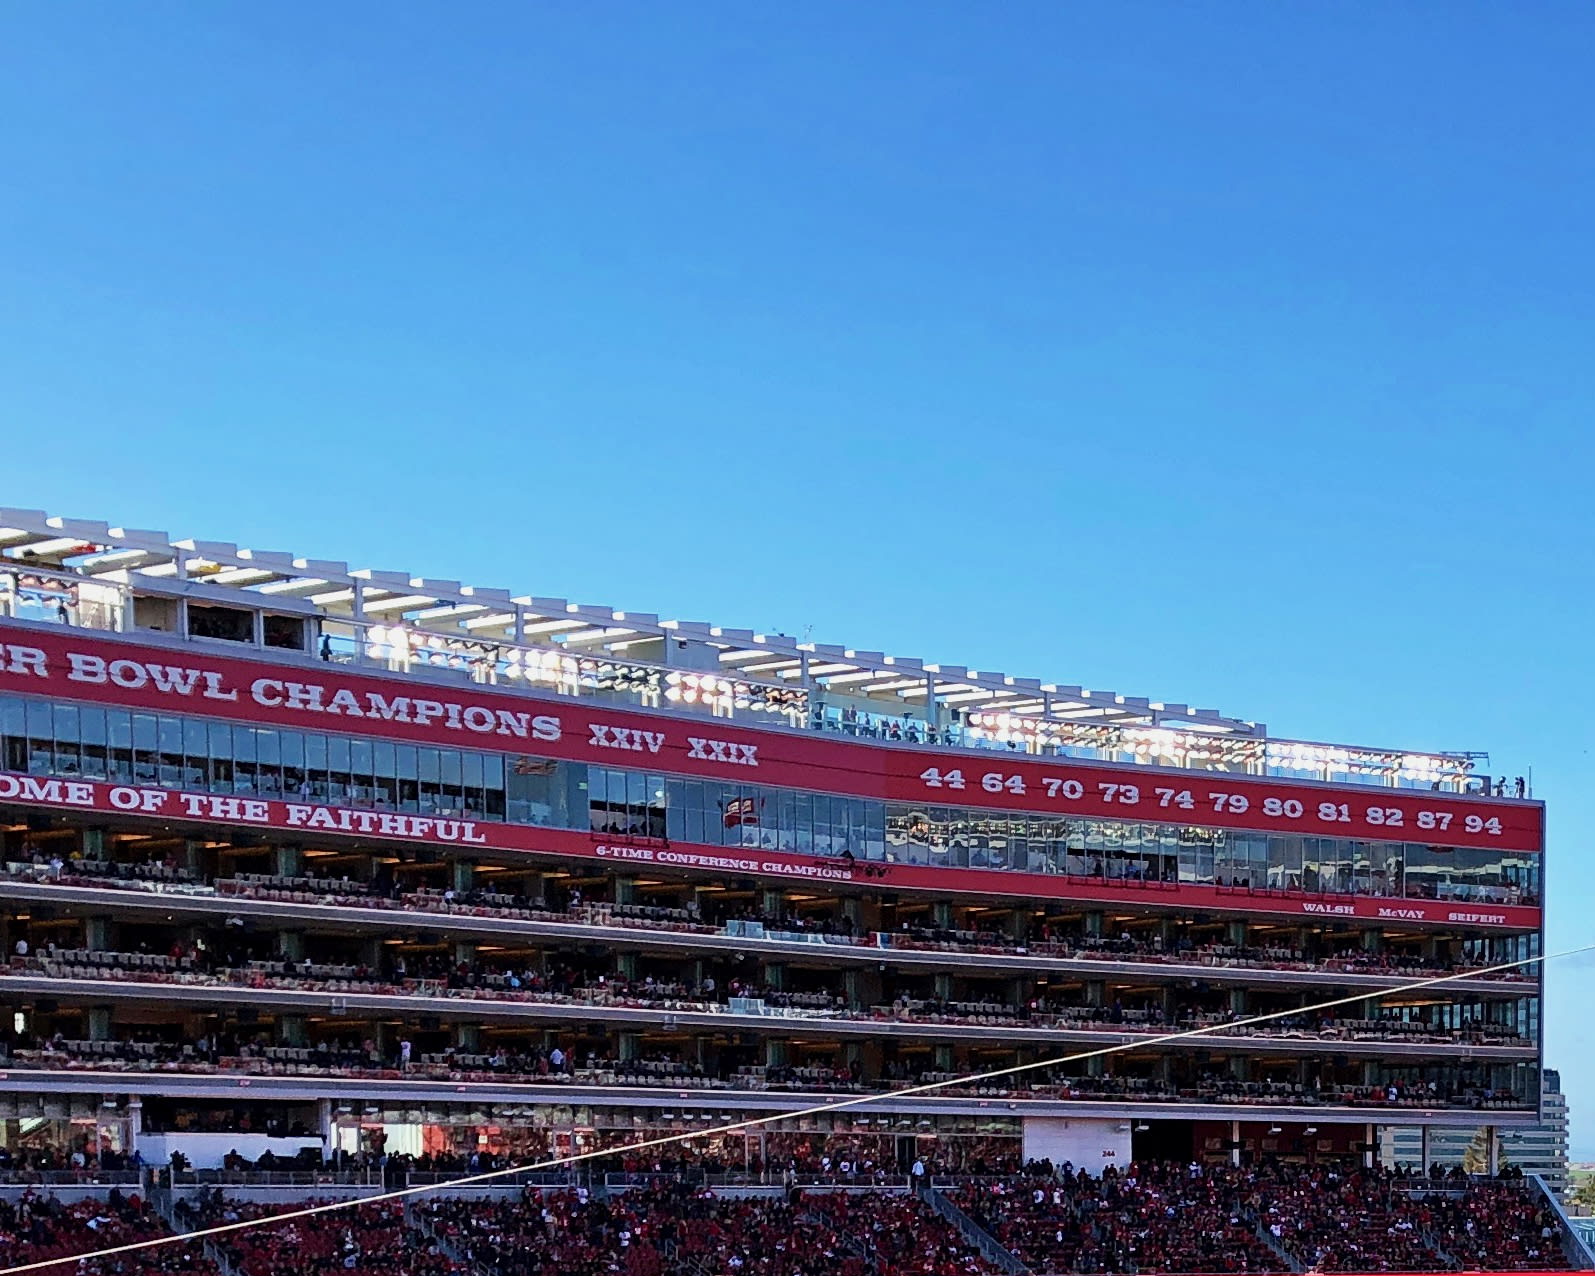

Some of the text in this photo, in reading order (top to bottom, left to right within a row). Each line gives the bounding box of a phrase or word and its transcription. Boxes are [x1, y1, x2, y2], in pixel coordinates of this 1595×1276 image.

[66, 652, 238, 702] BOWL
[250, 679, 562, 742] CHAMPIONS
[588, 723, 665, 754] XXIV
[687, 736, 759, 767] XXIX
[109, 787, 168, 812] OF
[180, 794, 269, 822] THE
[286, 804, 486, 843] FAITHFUL
[920, 767, 1502, 835] 44 64 70 73 74 79 80 81 82 87 94
[596, 845, 853, 880] 6-TIME CONFERENCE CHAMPIONS
[1303, 902, 1506, 925] WALSH McVAY SEIFERT
